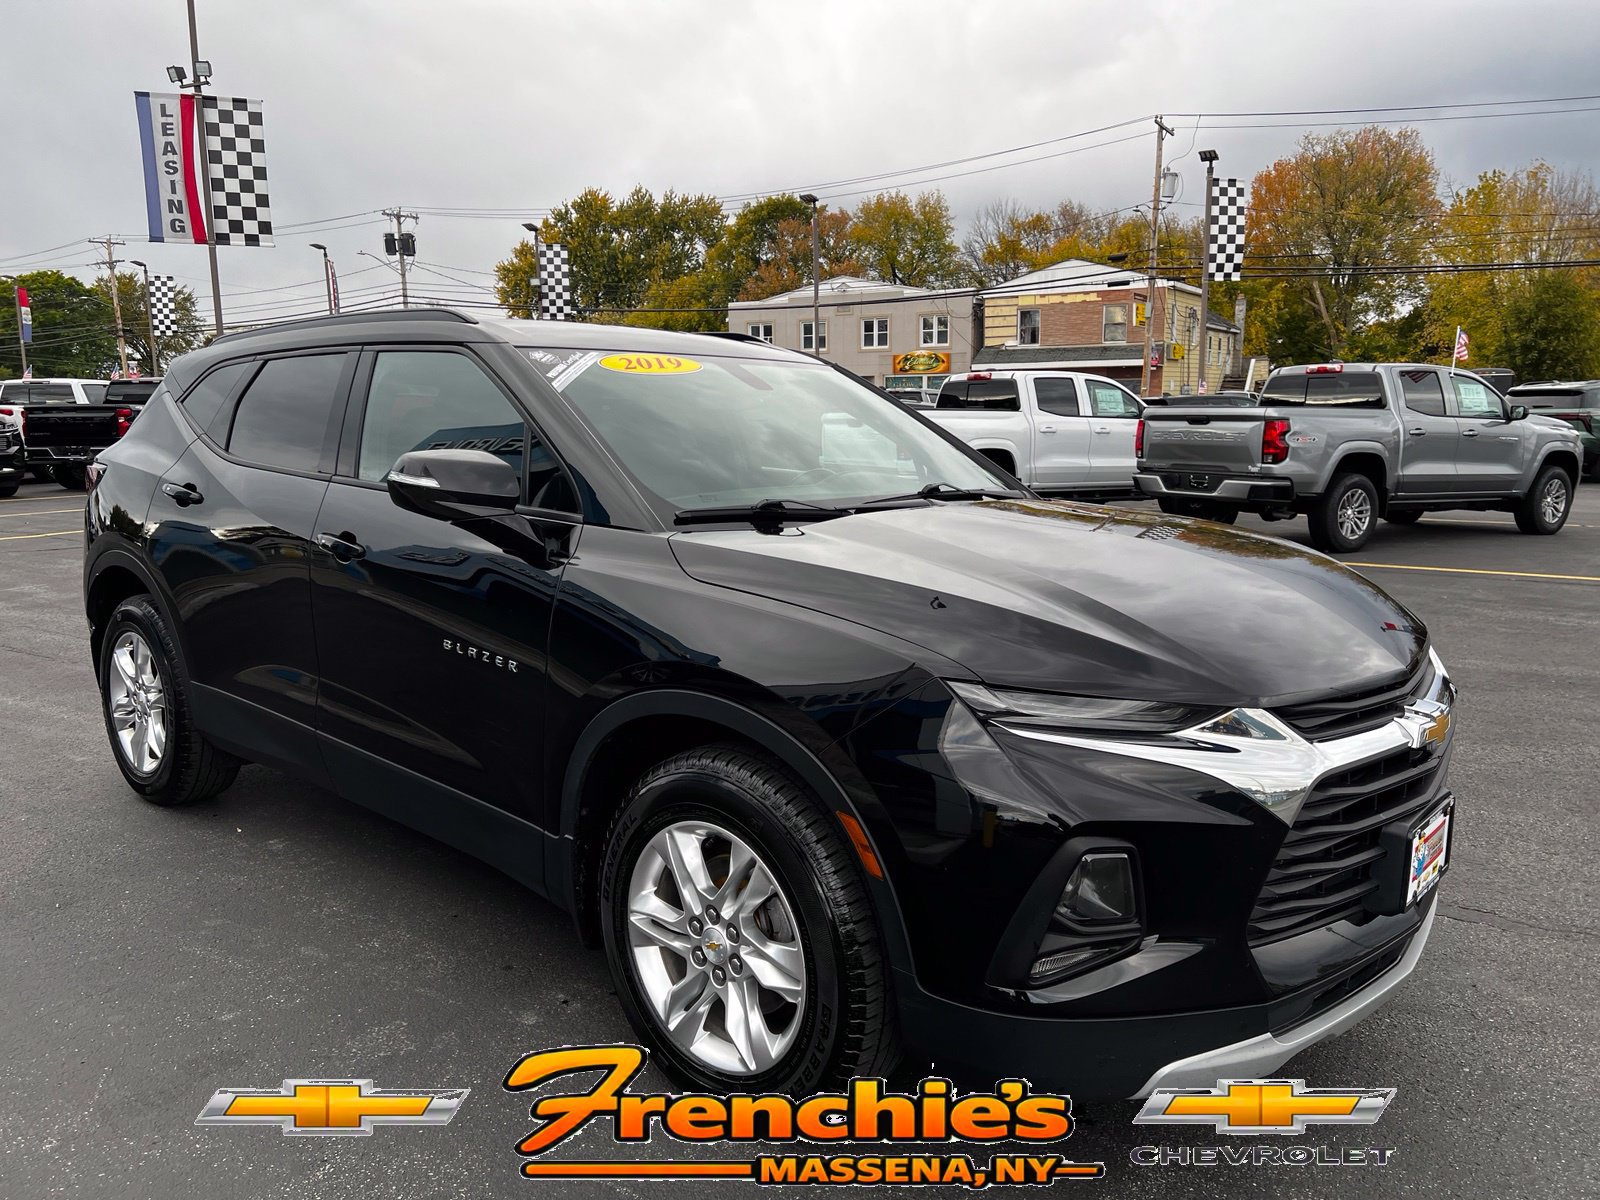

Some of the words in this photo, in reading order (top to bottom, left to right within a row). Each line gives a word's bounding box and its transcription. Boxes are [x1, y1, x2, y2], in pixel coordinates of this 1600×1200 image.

[160, 103, 186, 233] LEASING
[618, 357, 683, 370] 2019
[1151, 430, 1247, 442] CHEVROLET
[442, 639, 519, 673] BLAZER
